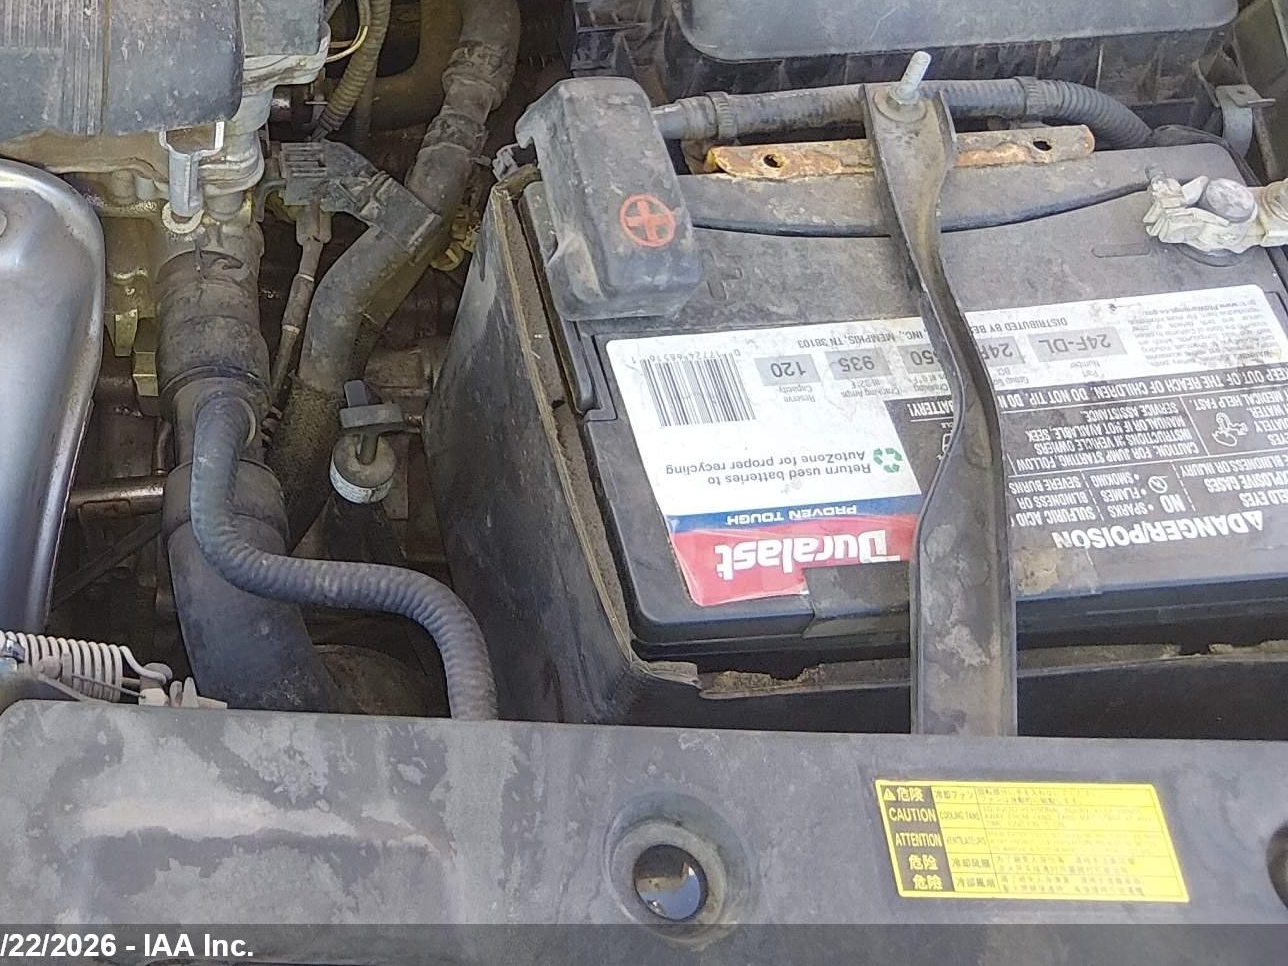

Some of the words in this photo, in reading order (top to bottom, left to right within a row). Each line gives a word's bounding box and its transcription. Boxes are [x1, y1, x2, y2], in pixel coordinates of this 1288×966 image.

[989, 323, 1002, 332] BY
[1004, 317, 1067, 331] DISTRIBUTED
[797, 338, 828, 349] 38103
[828, 338, 842, 346] TN
[1038, 334, 1110, 353] 24F-DL
[837, 355, 874, 372] 935
[910, 349, 938, 365] 50
[770, 361, 805, 377] 120
[1241, 369, 1264, 383] OUT
[1164, 376, 1201, 391] REACH
[1199, 374, 1224, 388] THE
[1226, 372, 1240, 385] OF
[778, 384, 812, 393] Capacity
[1149, 380, 1164, 393] OF
[783, 394, 815, 402] Reserve
[1006, 393, 1024, 407] DO
[1024, 391, 1047, 405] TIP.
[1047, 389, 1071, 403] NOT
[1070, 387, 1088, 401] DO
[1240, 390, 1283, 404] MEDICAL
[1139, 401, 1178, 416] SERVICE
[1188, 397, 1217, 410] FAST.
[1218, 395, 1243, 408] HELP
[1080, 406, 1138, 422] ASSISTANCE.
[1102, 421, 1122, 434] NOT
[1123, 420, 1133, 432] IF
[1131, 419, 1147, 431] OR
[1145, 415, 1185, 429] MANUAL
[1025, 428, 1050, 441] SEEK
[1125, 428, 1192, 445] INSTRUCTIONS
[1034, 440, 1075, 454] OWNERS
[1074, 436, 1112, 450] VEHICLE
[1152, 441, 1199, 456] CAUTION:
[801, 451, 864, 463] AutoZone
[1105, 448, 1130, 462] JUMP
[1130, 446, 1151, 459] FOR
[665, 461, 725, 475] recycling
[730, 456, 773, 469] proper
[778, 456, 797, 466] for
[1016, 456, 1056, 470] FOLLOW
[1213, 460, 1230, 472] OR
[1229, 455, 1283, 471] BLINDNESS
[788, 467, 820, 479] used
[825, 463, 870, 474] Return
[1180, 462, 1214, 476] INJURY
[707, 476, 720, 485] to
[725, 470, 784, 483] batteries
[1042, 475, 1081, 490] SEVERE
[1090, 471, 1133, 487] SMOKING
[1204, 475, 1240, 492] GASES
[1008, 479, 1043, 494] BURNS
[1033, 491, 1087, 507] BLINDNESS
[1100, 487, 1140, 501] FLAMES
[1239, 490, 1269, 507] EYES
[1016, 496, 1032, 509] OR
[1107, 502, 1147, 517] SPARKS
[1159, 494, 1185, 512] NO
[727, 511, 783, 524] TOUGH
[788, 505, 856, 520] PROVEN
[1015, 511, 1042, 526] ACID
[1043, 506, 1095, 523] SULFURIC
[714, 529, 902, 581] Duralast
[888, 807, 936, 822] CAUTION
[895, 832, 942, 846] ATTENTION
